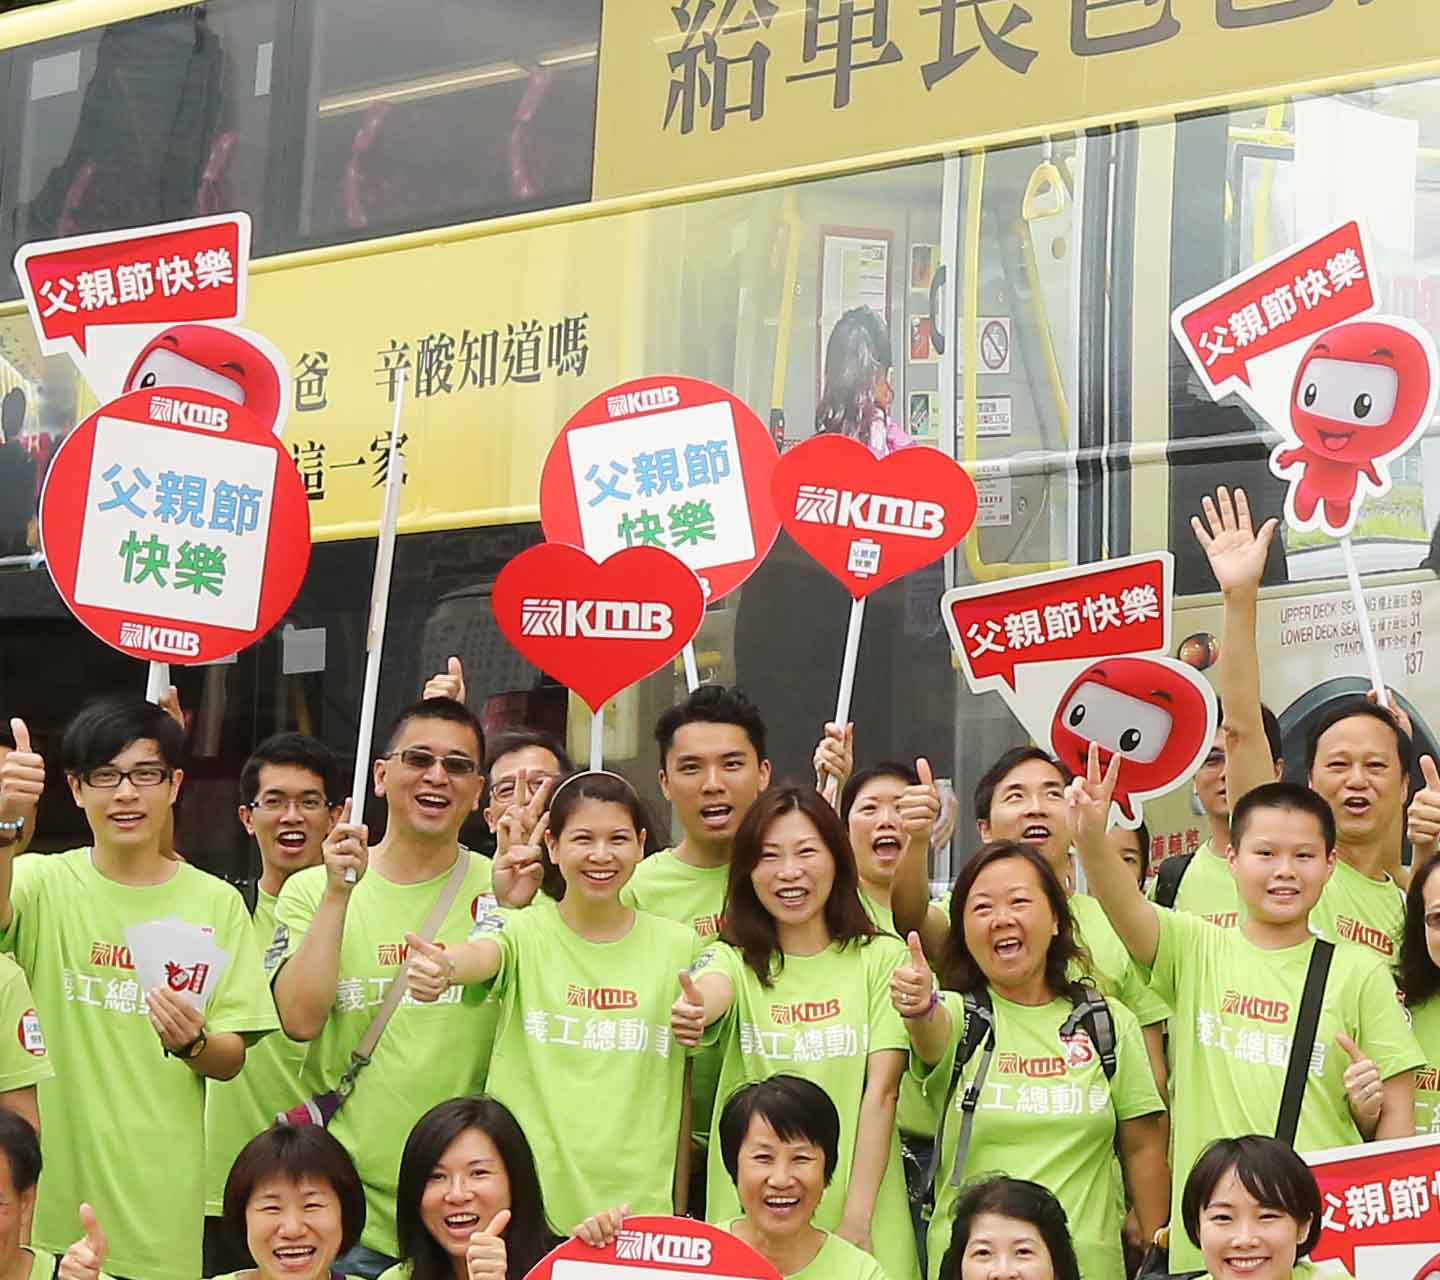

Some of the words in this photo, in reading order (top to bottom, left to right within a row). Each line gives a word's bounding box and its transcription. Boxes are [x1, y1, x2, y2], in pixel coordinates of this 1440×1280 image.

[39, 249, 234, 317] 父親節快樂
[1198, 245, 1365, 368] 父親節快樂
[628, 384, 681, 413] KMB
[171, 400, 229, 432] KMB
[584, 436, 731, 507] 父親節
[98, 463, 264, 535] 父親節
[836, 489, 946, 540] KMB
[617, 501, 717, 548] 快樂
[118, 529, 227, 596] 快樂
[564, 600, 673, 640] KMB
[966, 584, 1161, 660] 父親節快樂
[1280, 602, 1314, 624] UPPER
[1313, 601, 1337, 620] DECK
[1410, 589, 1423, 606] 59
[142, 625, 201, 657] KMB
[1280, 625, 1315, 646] LOWER
[1314, 624, 1338, 641] DECK
[1410, 612, 1421, 627] 31
[1409, 631, 1423, 648] 47
[1404, 650, 1424, 675] 137
[1352, 923, 1394, 957] KMB
[586, 986, 639, 1010] KMB
[789, 997, 841, 1025] KMB
[1240, 993, 1290, 1024] KMB
[1019, 1055, 1067, 1078] KMB
[642, 1233, 712, 1266] KMB
